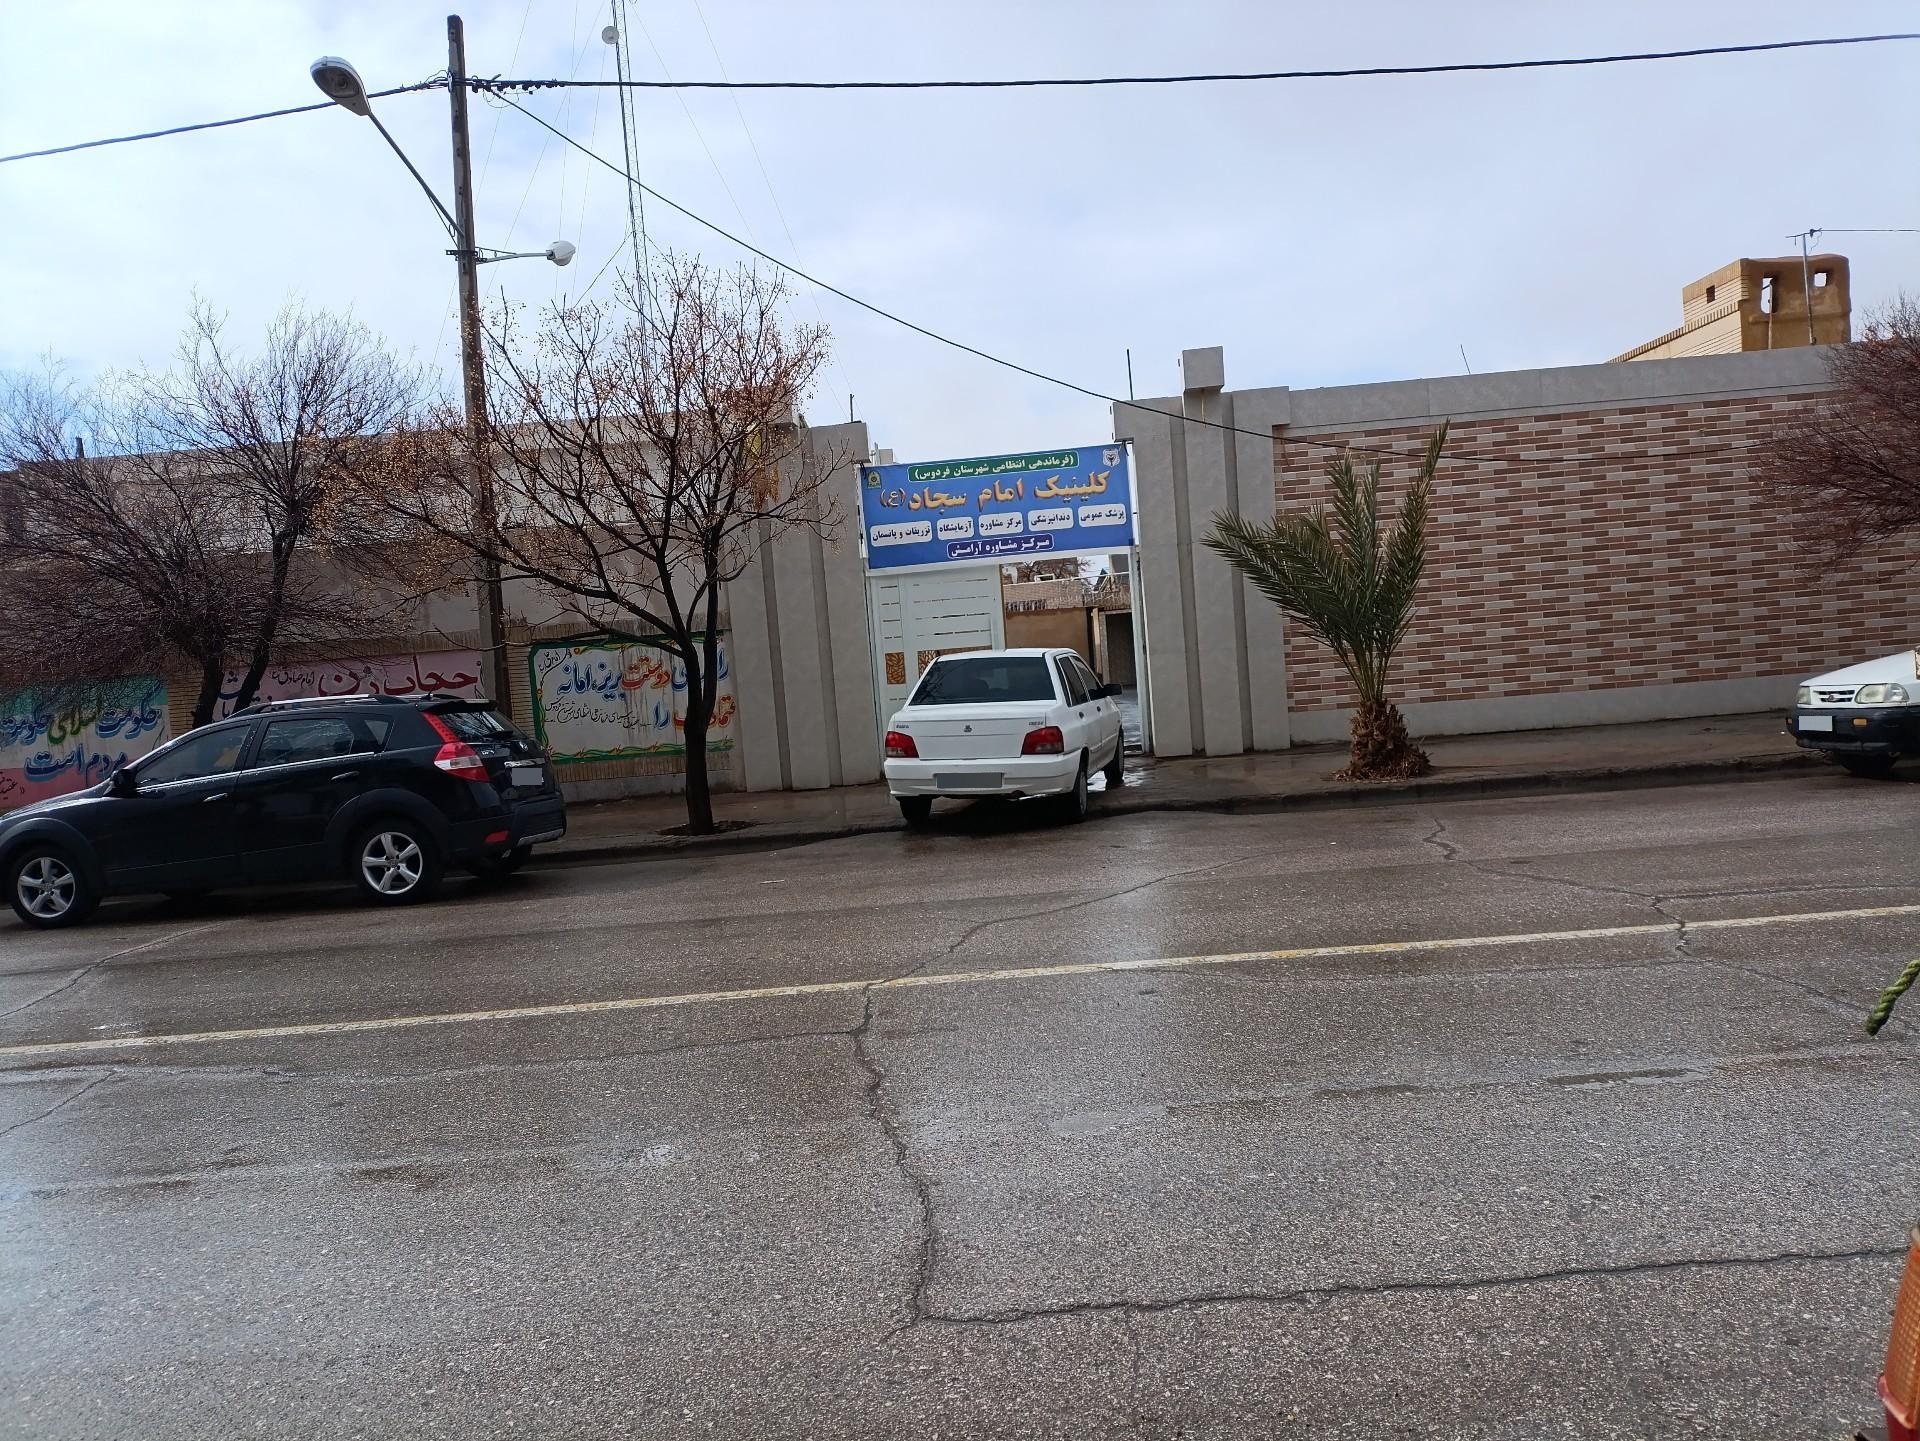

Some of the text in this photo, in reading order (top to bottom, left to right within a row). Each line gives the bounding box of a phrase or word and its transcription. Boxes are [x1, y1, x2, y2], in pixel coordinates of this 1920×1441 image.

[953, 463, 989, 477] شهرستان
[992, 459, 1025, 473] انتظامی
[1034, 470, 1111, 503] کلینیک
[908, 487, 967, 516] سجاد
[978, 478, 1024, 512] امام
[1080, 509, 1125, 521] پزشک عمومی
[939, 520, 972, 532] آزمایشگاه
[980, 518, 1022, 530] مرکز مشاوره
[872, 529, 897, 541] پانسمان
[905, 526, 931, 537] تزریقات
[951, 537, 1050, 556] مرکز مشاوره آرامش
